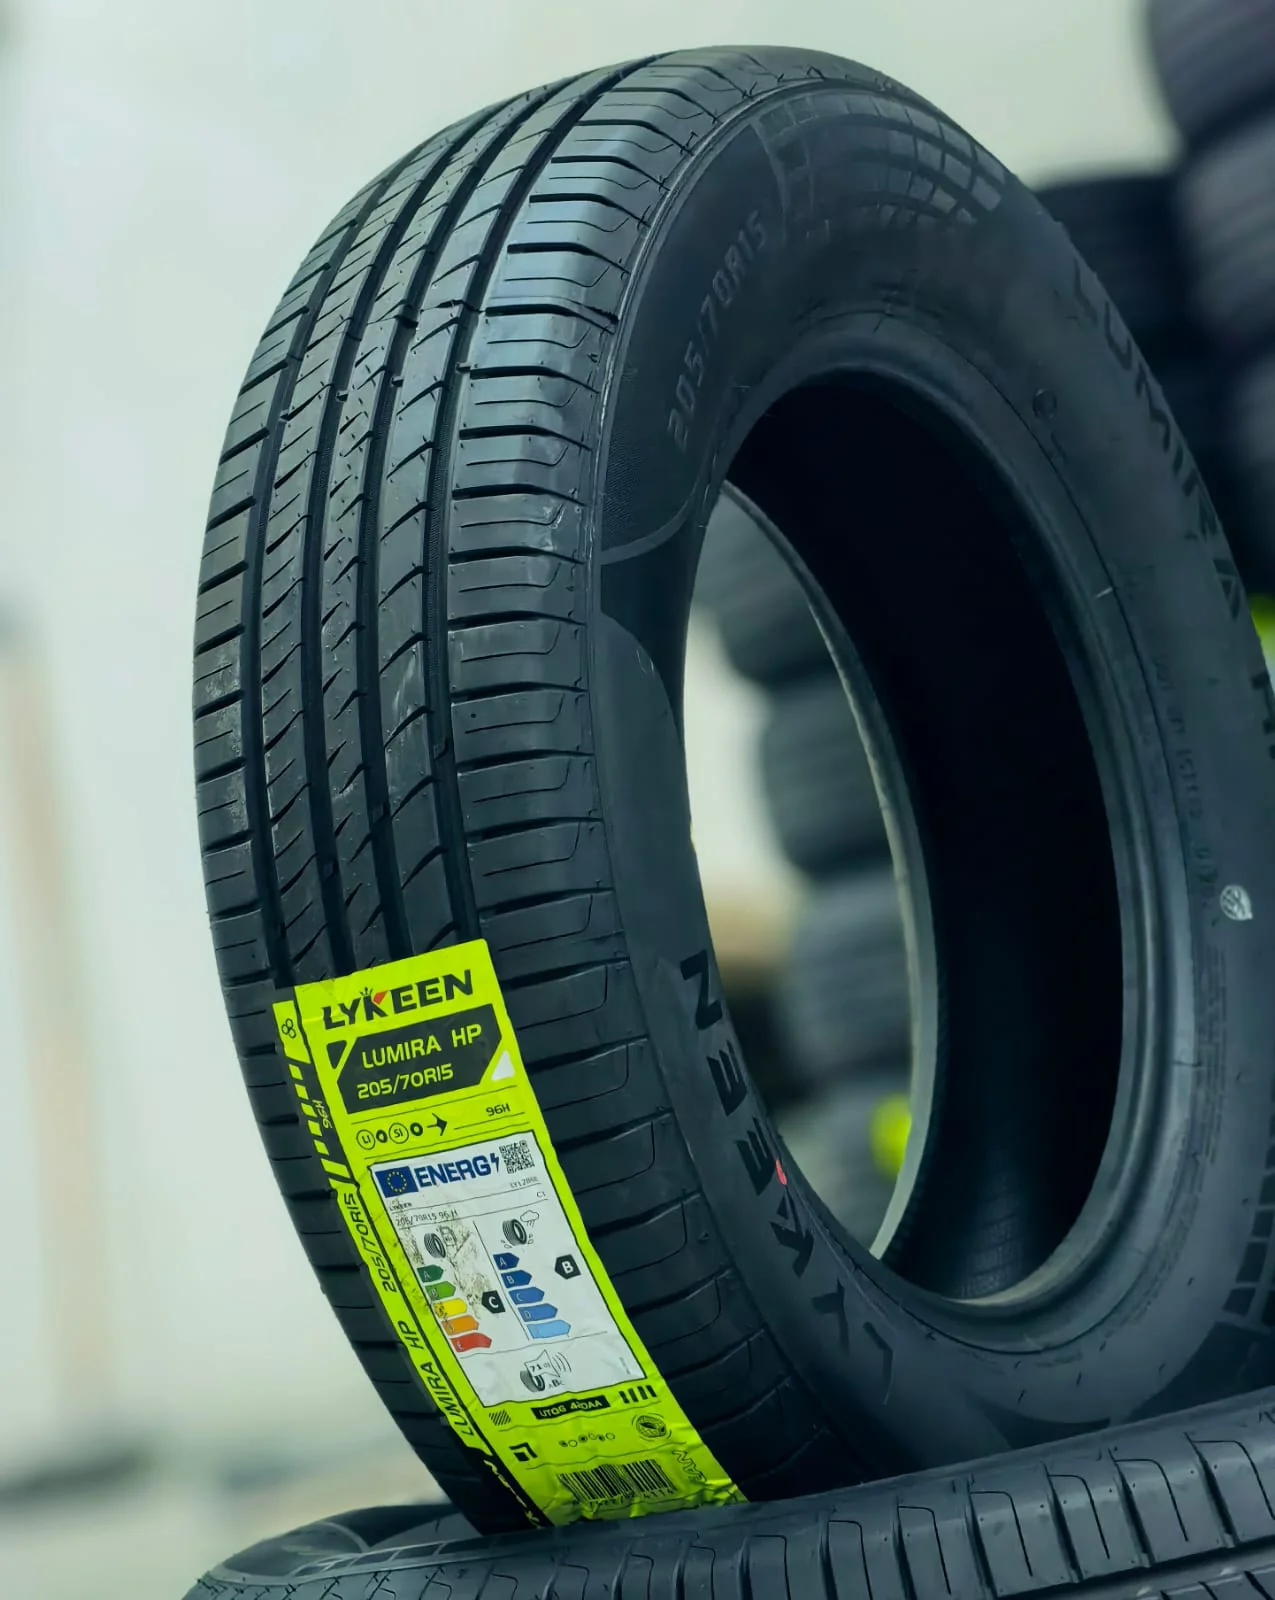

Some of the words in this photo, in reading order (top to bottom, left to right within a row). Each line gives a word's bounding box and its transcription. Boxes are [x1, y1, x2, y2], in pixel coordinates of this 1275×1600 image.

[322, 969, 474, 1031] LYKEEN
[361, 1035, 442, 1069] LUMIRA
[451, 1023, 483, 1048] HP
[356, 1063, 454, 1100] 205/70R15
[485, 1103, 511, 1117] 96H
[681, 950, 894, 1406] LYKEEN
[343, 1191, 397, 1293] 205/70R15
[561, 1261, 574, 1274] B
[488, 1296, 499, 1308] C
[398, 1321, 425, 1350] HP
[530, 1364, 542, 1372] 71
[420, 1361, 475, 1437] LUMIRA
